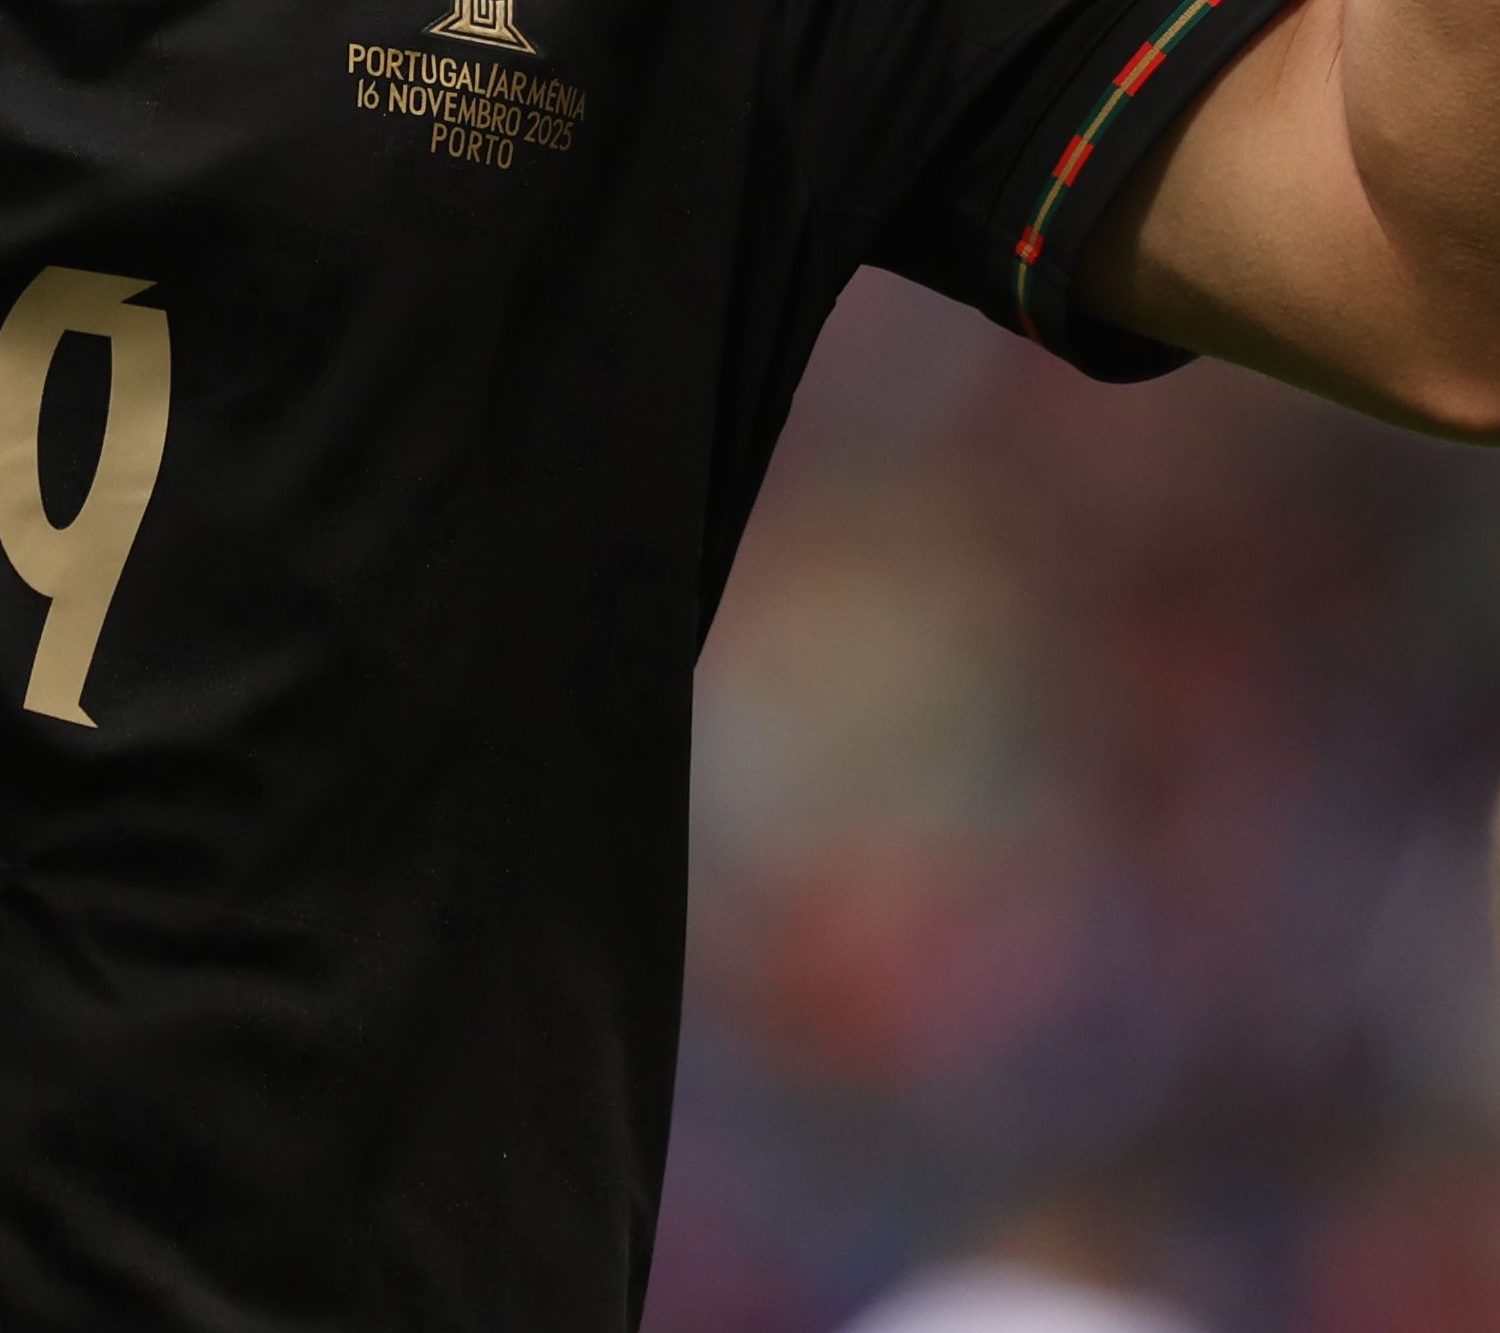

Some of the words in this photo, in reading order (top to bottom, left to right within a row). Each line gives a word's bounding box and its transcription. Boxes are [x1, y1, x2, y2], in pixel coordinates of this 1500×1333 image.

[348, 43, 586, 122] PORTUGAL/ARMÉNIA
[356, 78, 380, 110] 16
[388, 82, 522, 138] NOVEMBRO
[523, 110, 575, 151] 2025
[430, 122, 514, 170] PORTO
